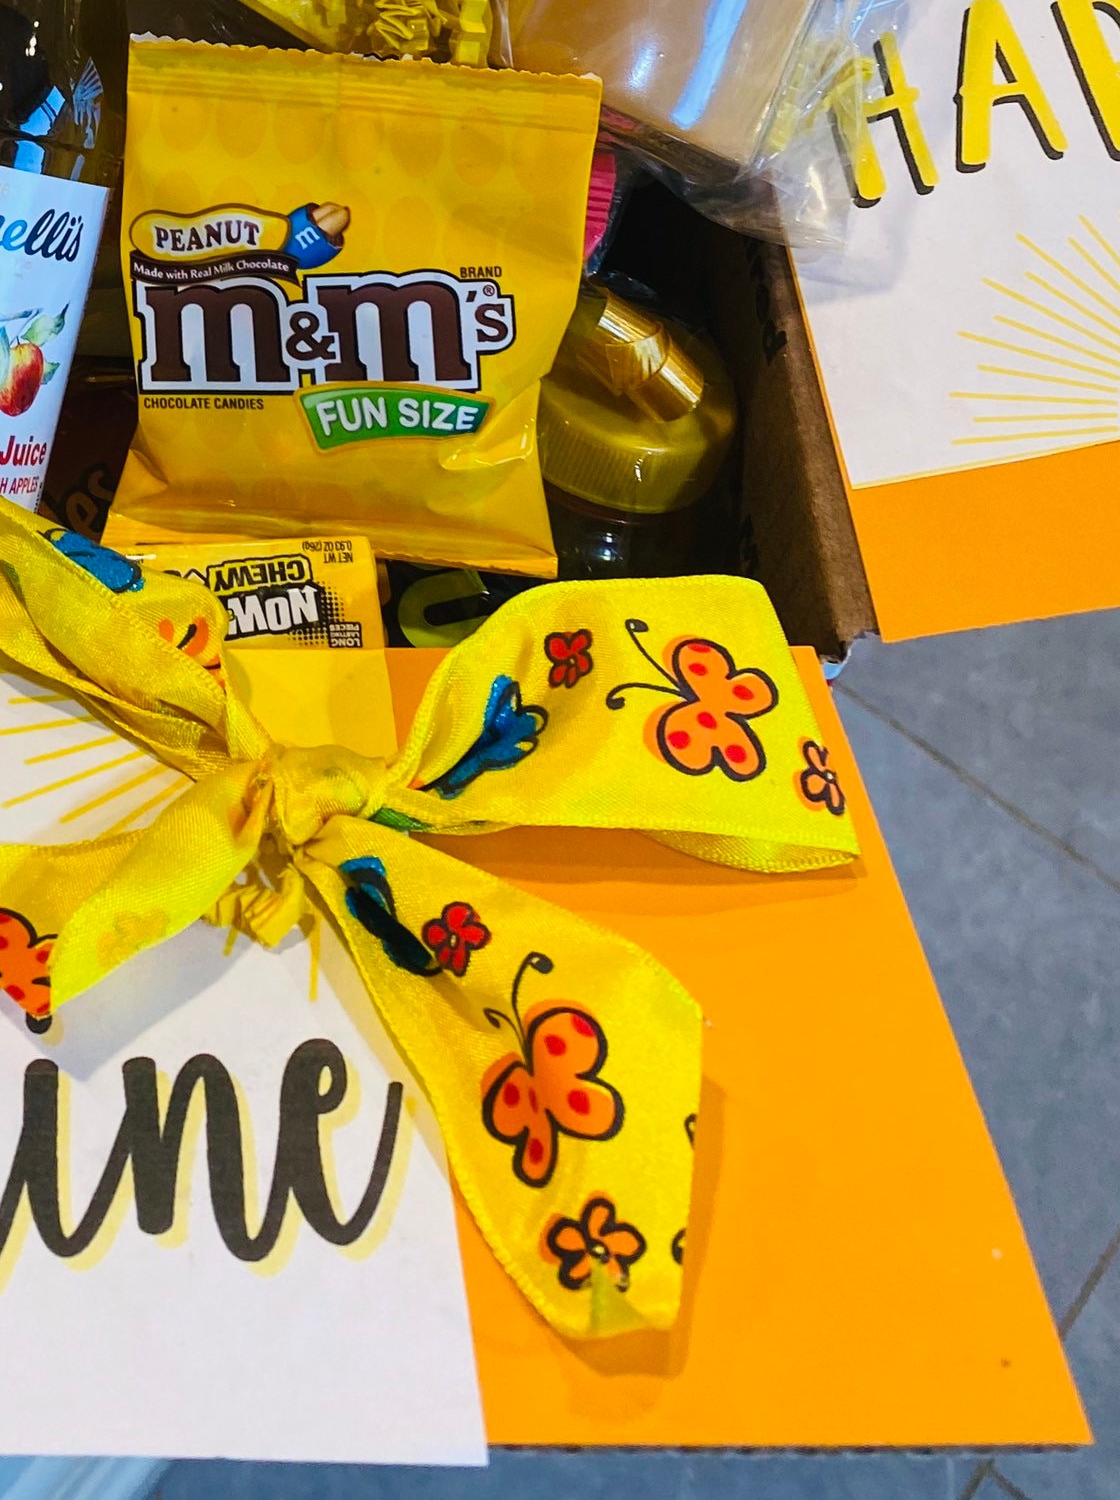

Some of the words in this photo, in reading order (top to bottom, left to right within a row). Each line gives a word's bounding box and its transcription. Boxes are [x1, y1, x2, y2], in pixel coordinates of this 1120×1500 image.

[154, 218, 261, 253] PEANUT
[133, 262, 164, 280] Made
[165, 268, 189, 282] with
[189, 263, 213, 279] Real
[213, 261, 235, 275] Milk
[235, 258, 290, 274] Chocolate
[459, 265, 502, 278] BRAND
[143, 396, 211, 410] CHOCOLATE
[213, 397, 265, 411] CANDIES
[316, 396, 388, 438] FUN
[397, 398, 481, 432] SIZE
[8, 475, 40, 496] APPLES
[322, 541, 335, 552] OZ
[323, 553, 337, 565] WT
[336, 553, 354, 564] NET
[213, 558, 307, 592] CHEWY
[329, 623, 360, 632] PIECES
[330, 637, 362, 647] LONG
